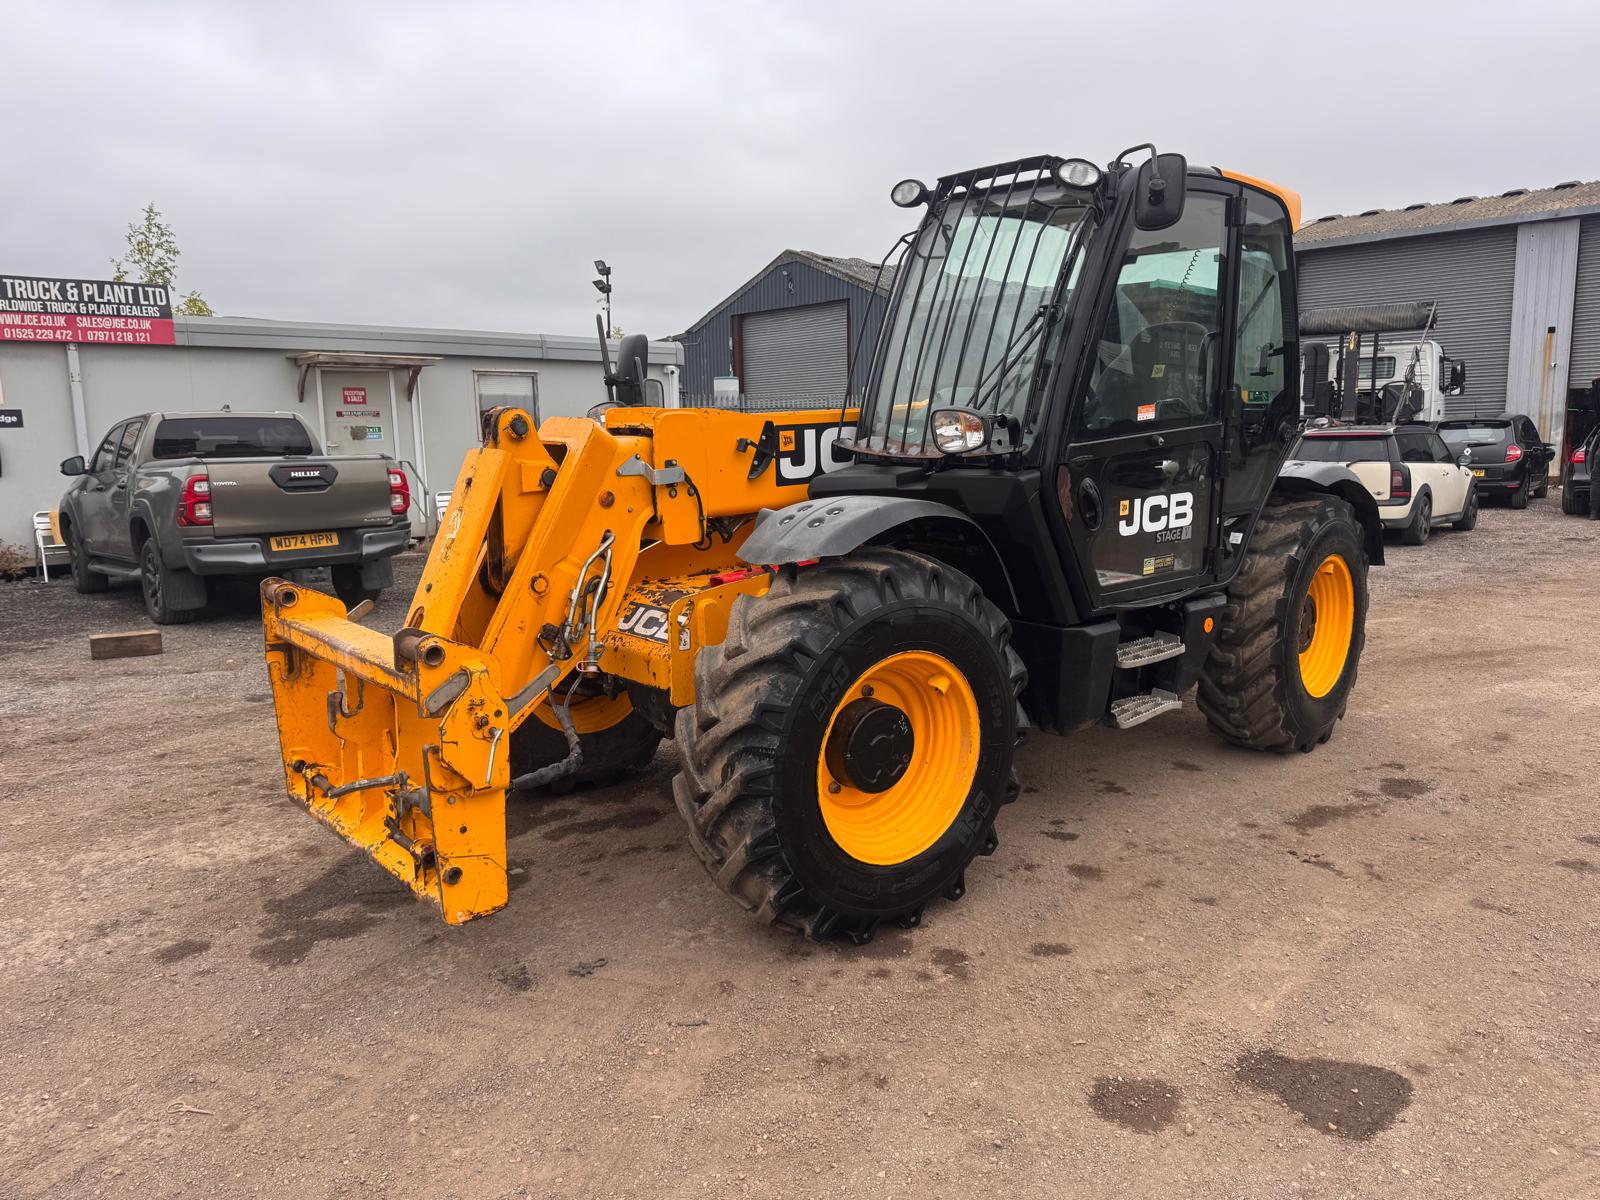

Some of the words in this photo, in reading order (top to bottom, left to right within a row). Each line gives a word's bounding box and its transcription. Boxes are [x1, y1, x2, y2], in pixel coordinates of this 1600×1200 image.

[3, 278, 62, 300] TRUCK
[66, 283, 79, 301] &
[82, 283, 135, 304] PLANT
[138, 286, 167, 306] LTD
[45, 301, 78, 314] TRUCK
[79, 303, 87, 314] &
[88, 303, 118, 315] PLANT
[120, 305, 160, 317] DEALERS
[4, 328, 34, 339] 01525
[36, 329, 54, 339] 229
[55, 330, 73, 340] 472
[87, 331, 115, 342] 07971
[116, 332, 133, 342] 218
[136, 332, 151, 343] 121
[780, 426, 858, 479] JC
[291, 470, 320, 478] HILUX
[1119, 492, 1193, 536] JCB
[275, 535, 306, 549] WD74
[310, 533, 333, 546] HPN
[1156, 528, 1181, 543] STAGE
